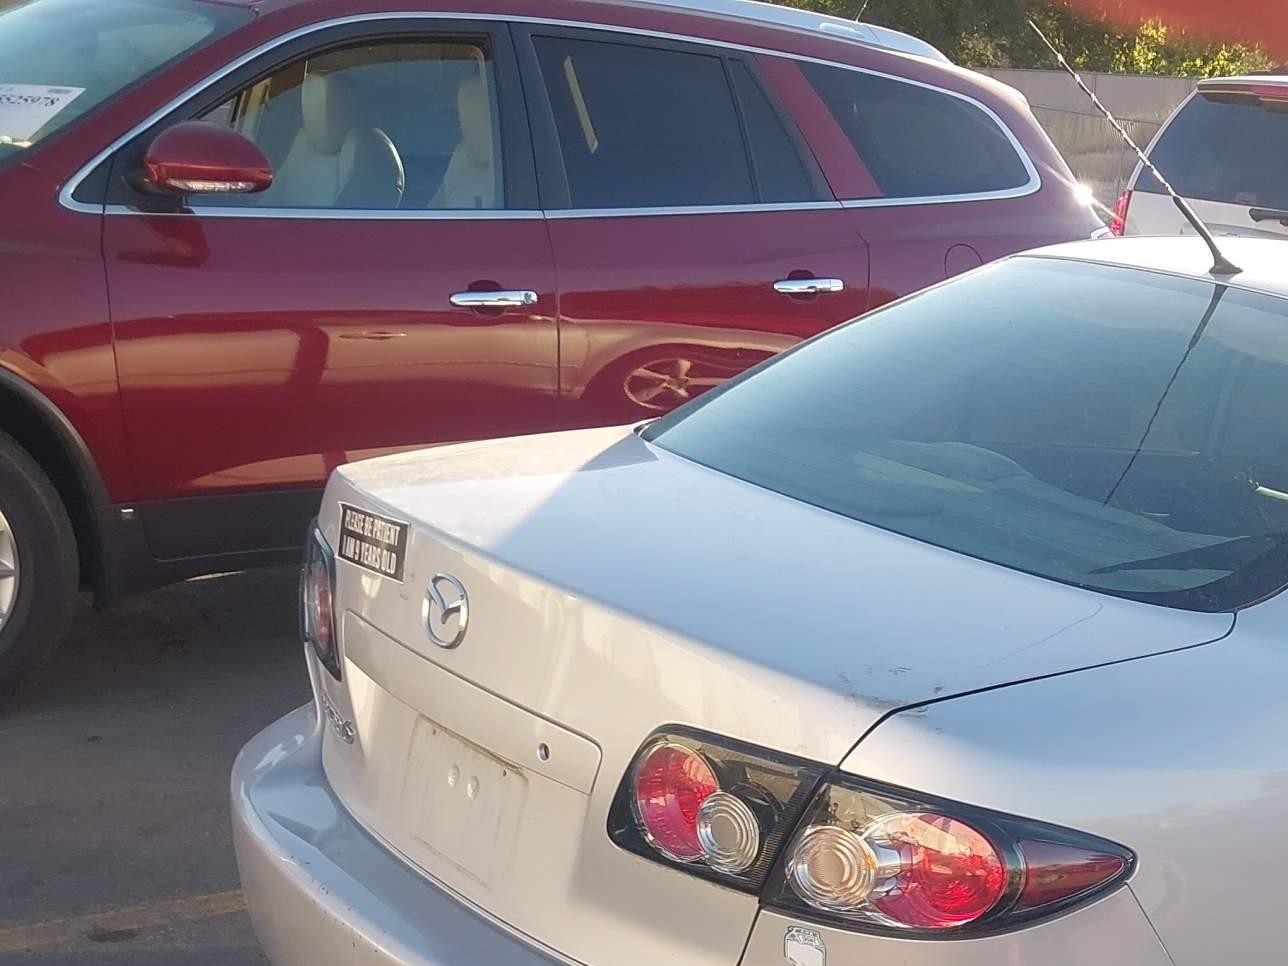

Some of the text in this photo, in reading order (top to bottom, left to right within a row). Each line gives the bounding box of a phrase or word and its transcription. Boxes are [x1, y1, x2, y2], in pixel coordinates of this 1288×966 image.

[345, 509, 400, 546] PLEASE BE PATIENT
[346, 536, 355, 559] AM
[361, 541, 380, 568] YEARS
[381, 549, 397, 574] OLD
